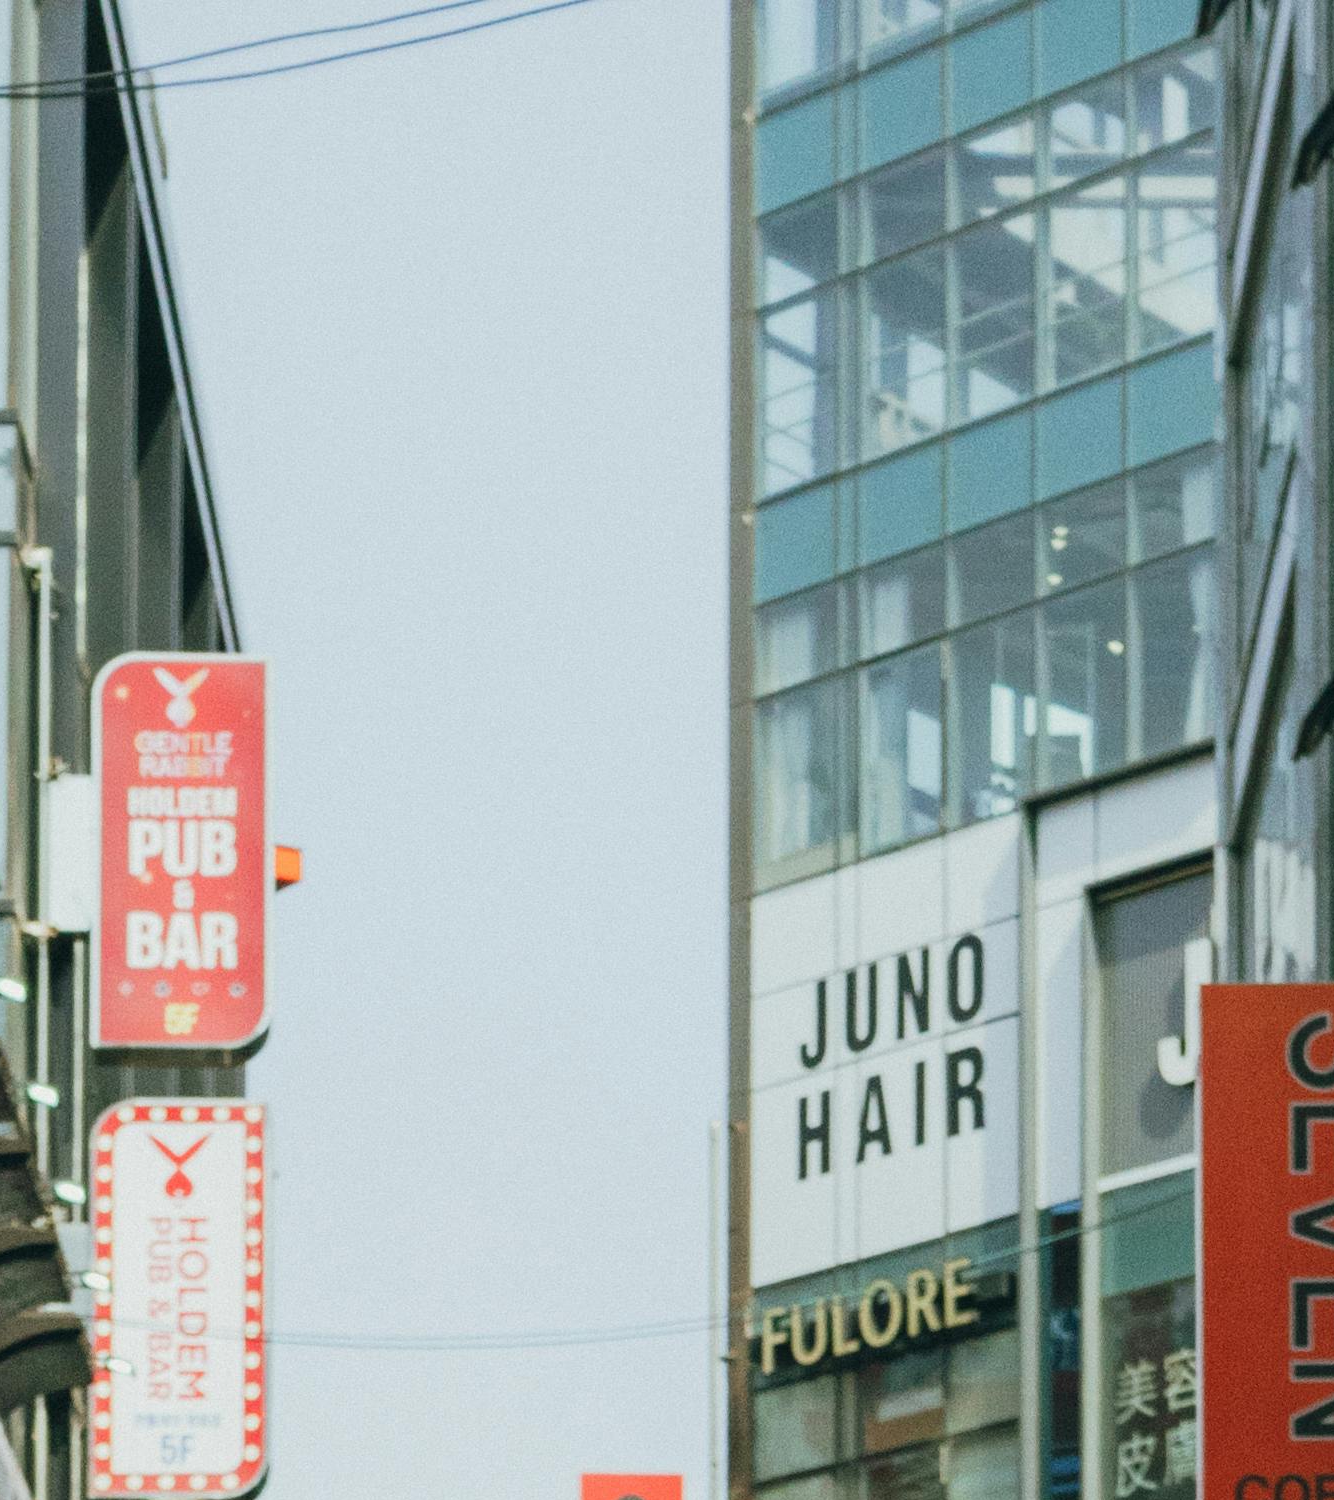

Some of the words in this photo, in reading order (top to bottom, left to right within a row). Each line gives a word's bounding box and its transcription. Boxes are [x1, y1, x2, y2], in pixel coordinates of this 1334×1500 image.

[127, 819, 238, 878] PUB
[172, 879, 196, 910] &
[125, 910, 239, 970] BAR
[800, 932, 985, 1069] JUNO
[797, 1046, 986, 1181] HAIR
[178, 1216, 210, 1401] HOLDEM
[759, 1258, 980, 1376] FULORE
